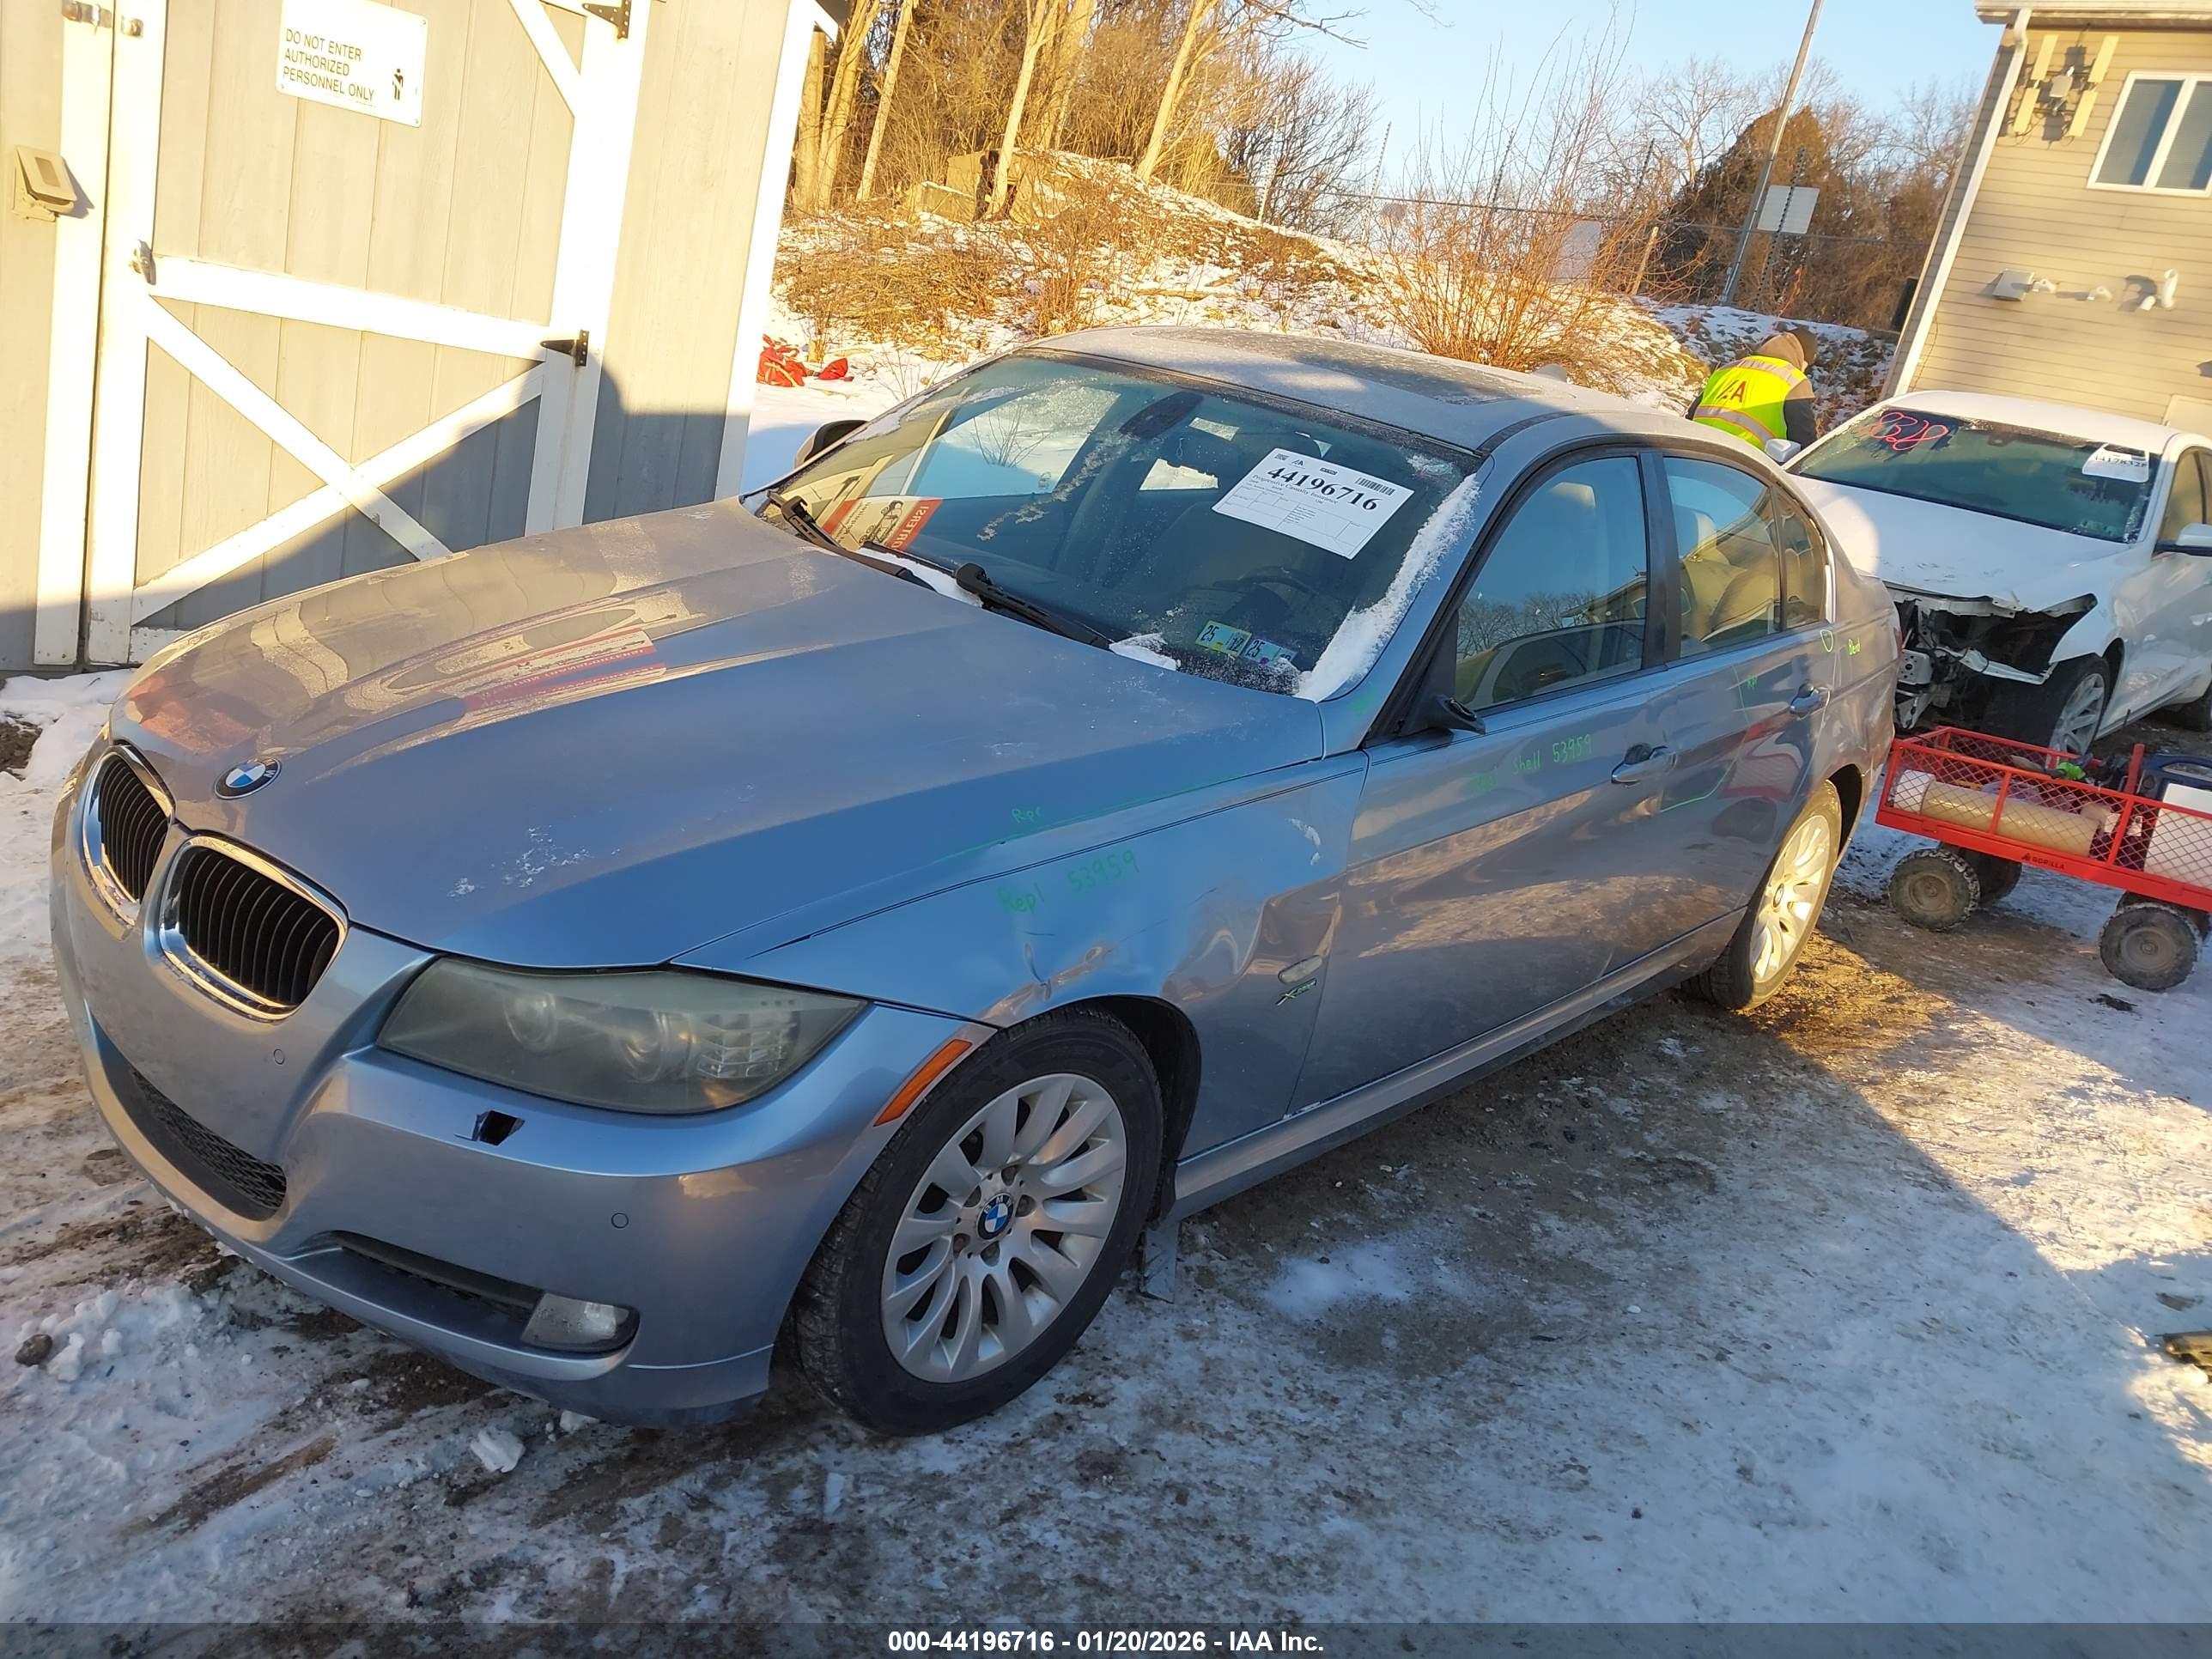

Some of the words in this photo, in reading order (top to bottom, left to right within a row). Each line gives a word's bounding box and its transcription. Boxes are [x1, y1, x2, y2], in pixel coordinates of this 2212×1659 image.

[286, 28, 301, 45] DO
[304, 34, 325, 51] NOT
[328, 40, 362, 62] ENTER
[284, 48, 350, 76] AUTHORIZED
[283, 66, 345, 94] PERSONNEL
[348, 83, 375, 101] ONLY
[1267, 467, 1382, 511] 44196716
[1200, 624, 1219, 642] 25
[1229, 637, 1244, 652] 12
[1247, 640, 1266, 658] 25
[1553, 733, 1593, 763] 53959
[2032, 856, 2065, 870] GORILLA
